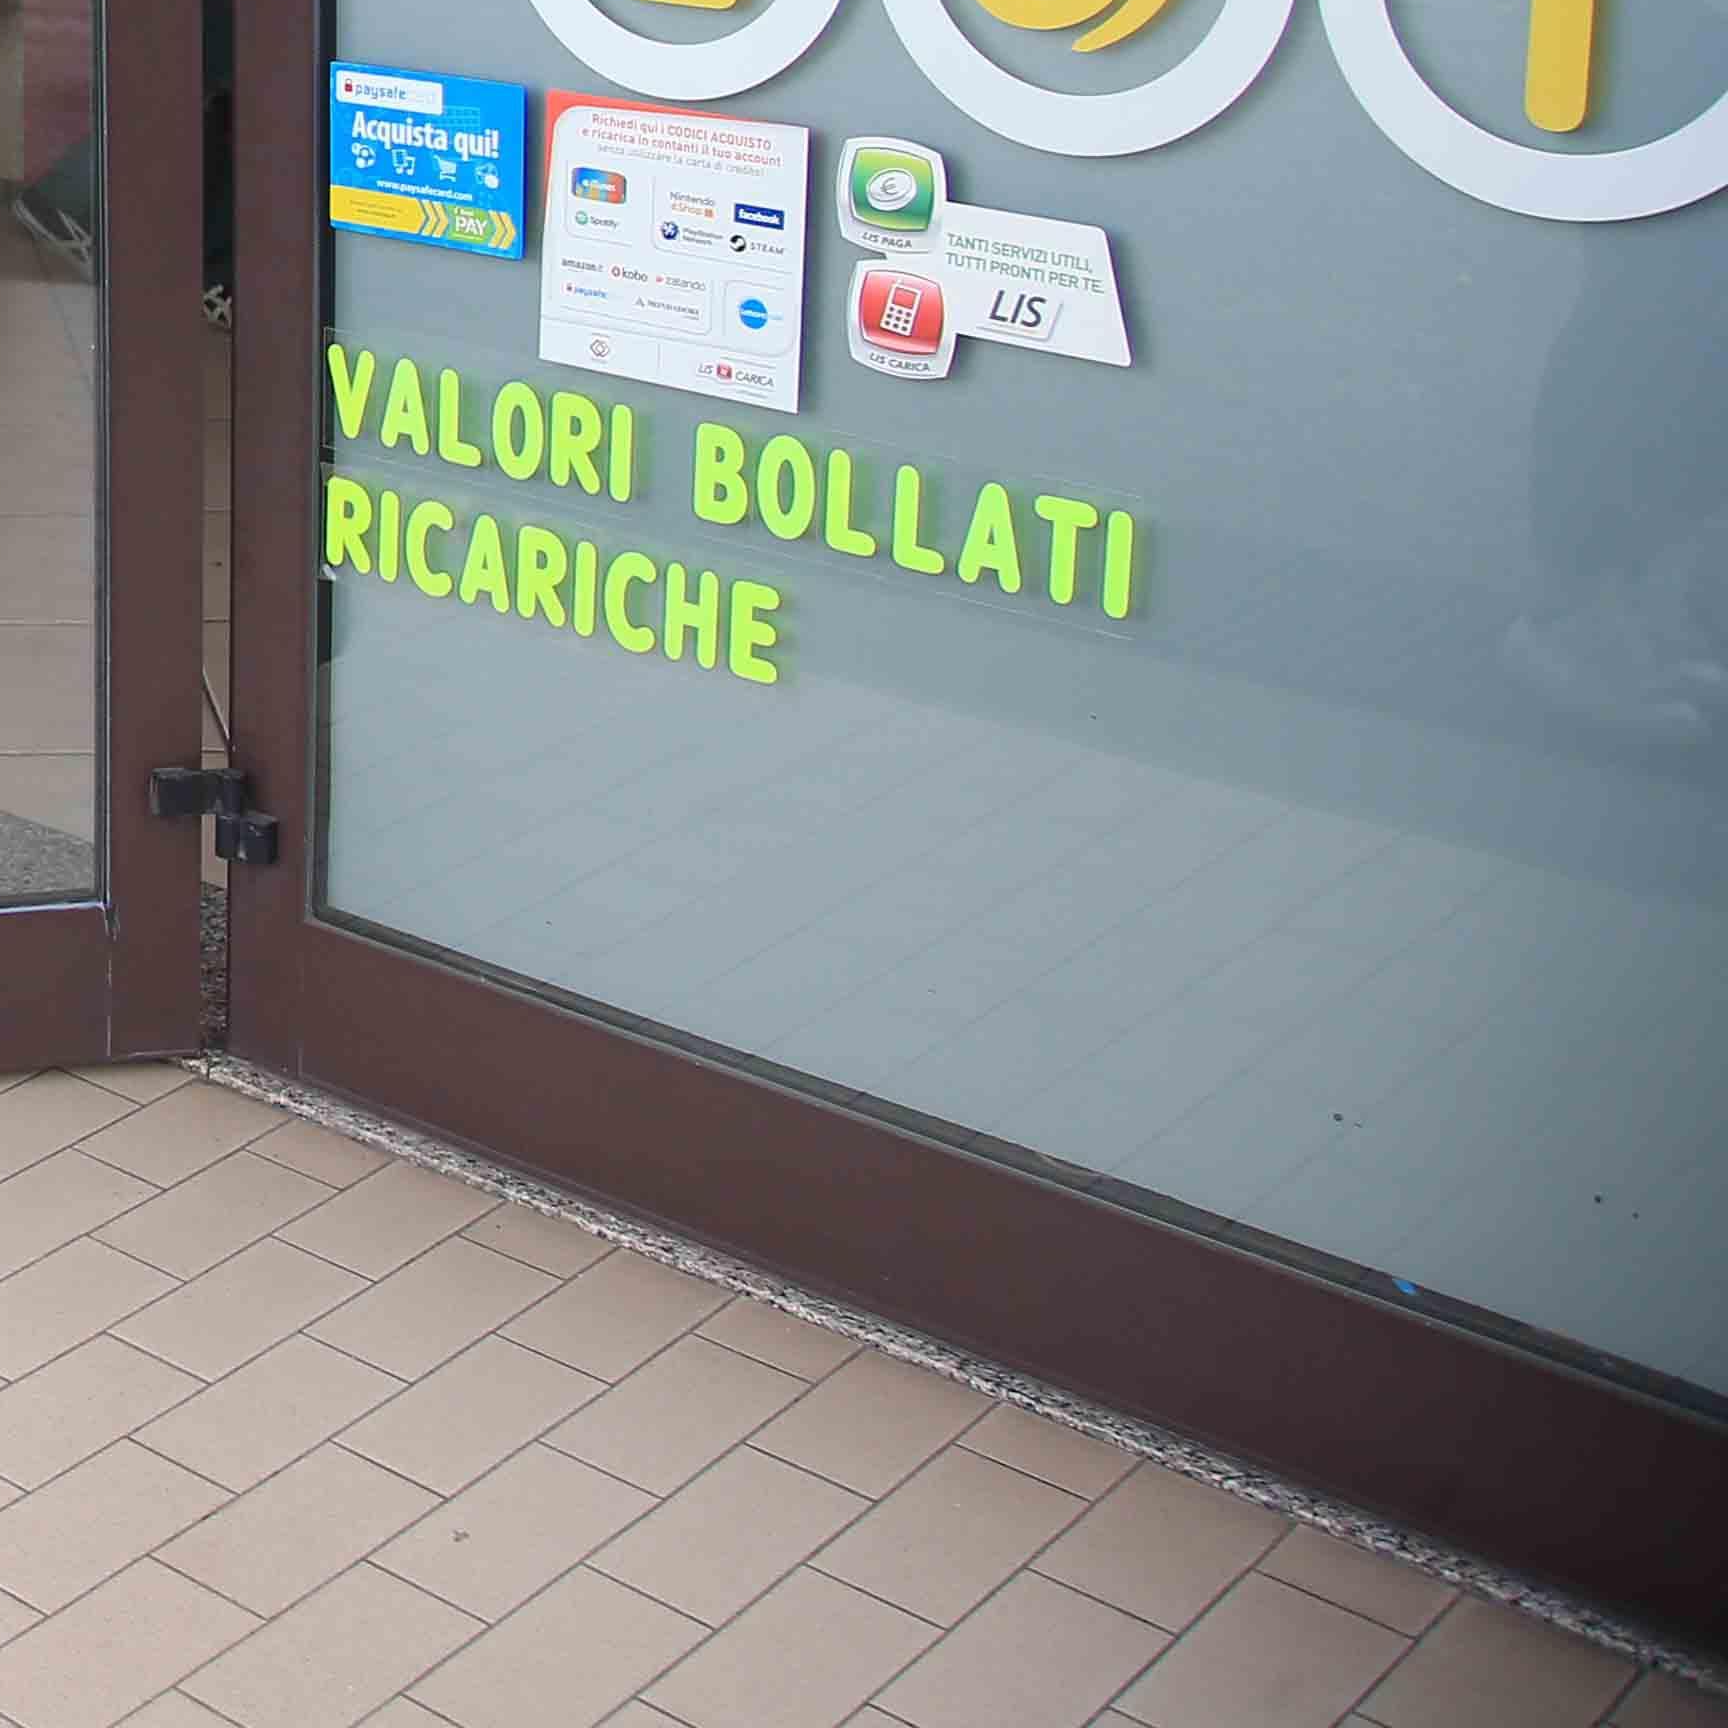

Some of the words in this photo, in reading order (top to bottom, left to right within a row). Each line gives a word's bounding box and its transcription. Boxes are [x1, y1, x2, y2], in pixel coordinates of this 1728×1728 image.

[351, 110, 448, 151] Acquista
[454, 128, 500, 161] qui!
[591, 128, 636, 145] ricarica
[651, 136, 699, 153] contanti
[711, 146, 730, 159] tuo
[734, 149, 781, 167] account
[592, 113, 638, 131] Richiedi
[642, 122, 659, 136] qui
[667, 125, 708, 141] CODICI
[711, 130, 772, 152] ACQUISTO
[670, 191, 715, 207] Nintendo
[456, 216, 488, 236] PAY
[862, 231, 879, 244] LIS
[881, 236, 912, 249] PAGA
[749, 240, 785, 256] STEAM
[947, 233, 989, 252] TANTI
[992, 241, 1048, 264] SERVIZI
[622, 267, 648, 283] kobo
[946, 252, 987, 273] TUTTI
[991, 262, 1045, 284] PRONTI
[1048, 271, 1079, 288] PER
[989, 289, 1046, 328] LIS
[869, 351, 886, 364] LIS
[888, 356, 931, 372] CARICA
[735, 371, 776, 388] CARICA
[327, 343, 634, 504] VALORI
[693, 422, 1135, 620] BOLLATI
[325, 474, 781, 685] RICARICHE
